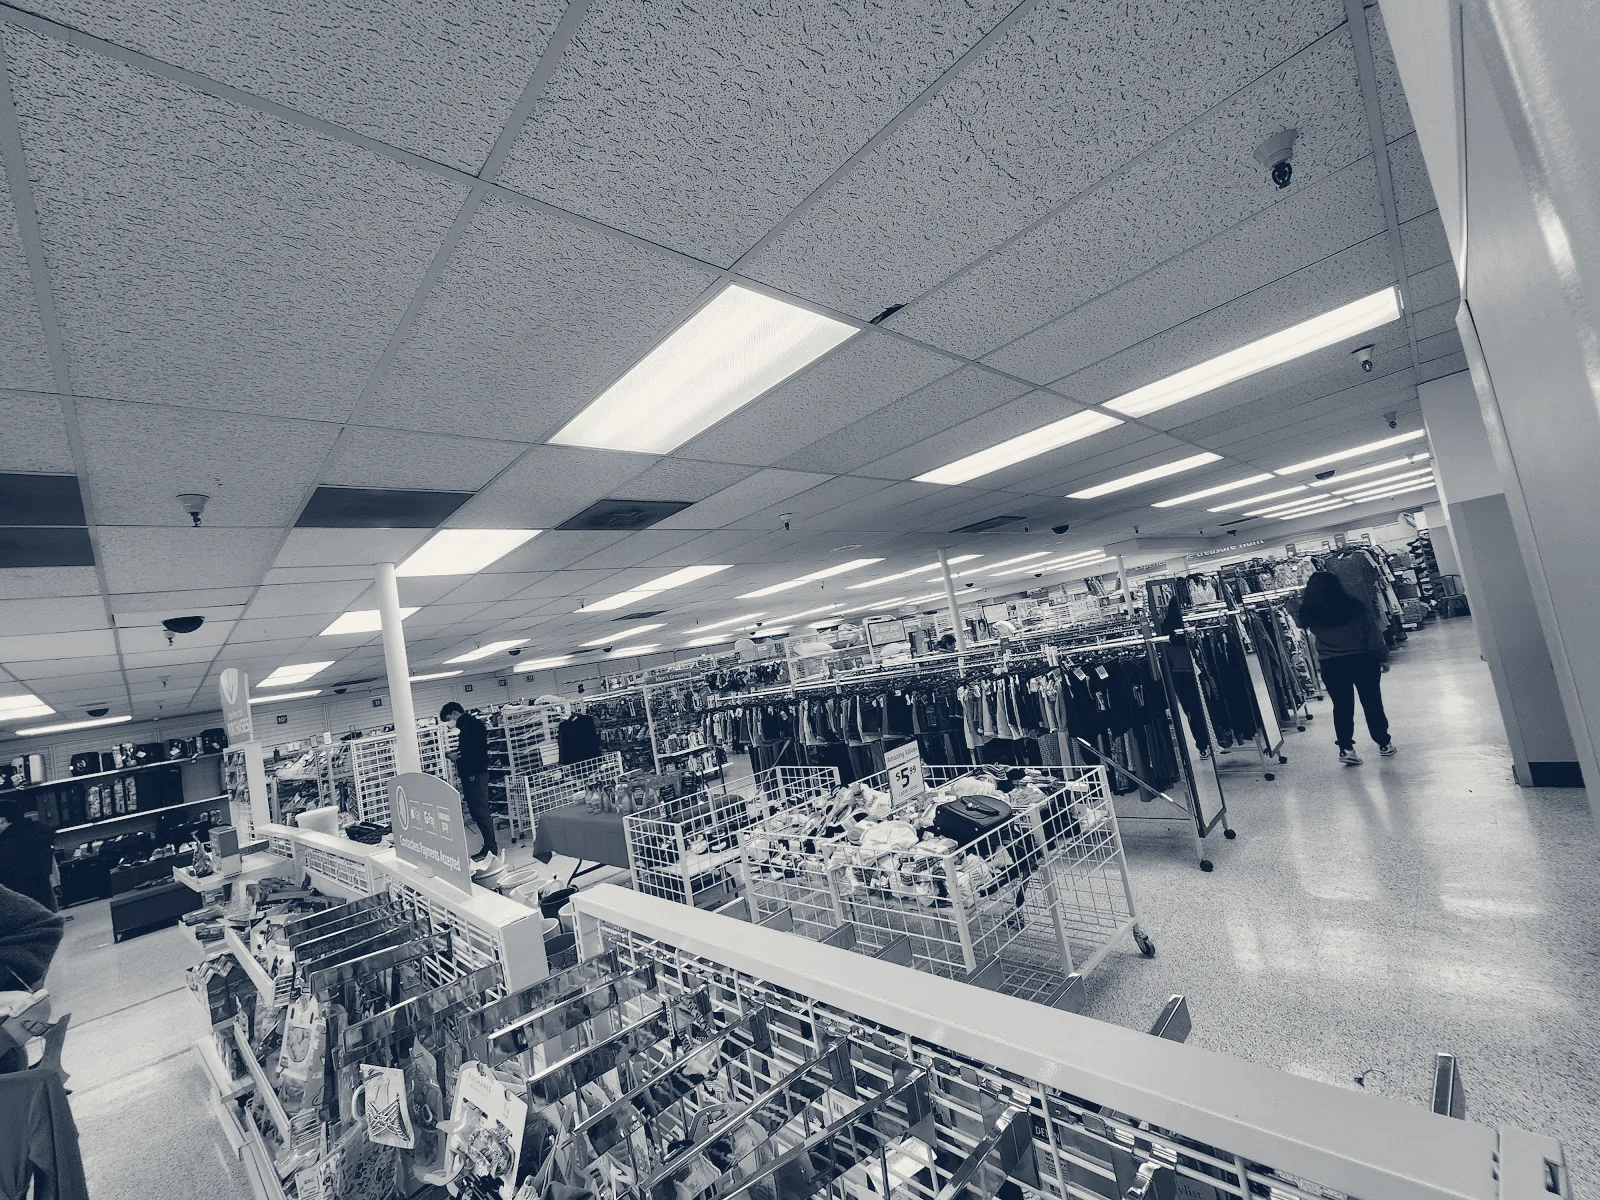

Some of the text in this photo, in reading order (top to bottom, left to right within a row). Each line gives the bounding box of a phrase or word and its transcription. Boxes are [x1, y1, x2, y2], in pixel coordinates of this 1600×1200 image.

[1196, 545, 1237, 557] treasure
[669, 672, 692, 680] Grooming
[887, 751, 905, 764] Amazing
[399, 834, 461, 872] Contactless Payments Accepted
